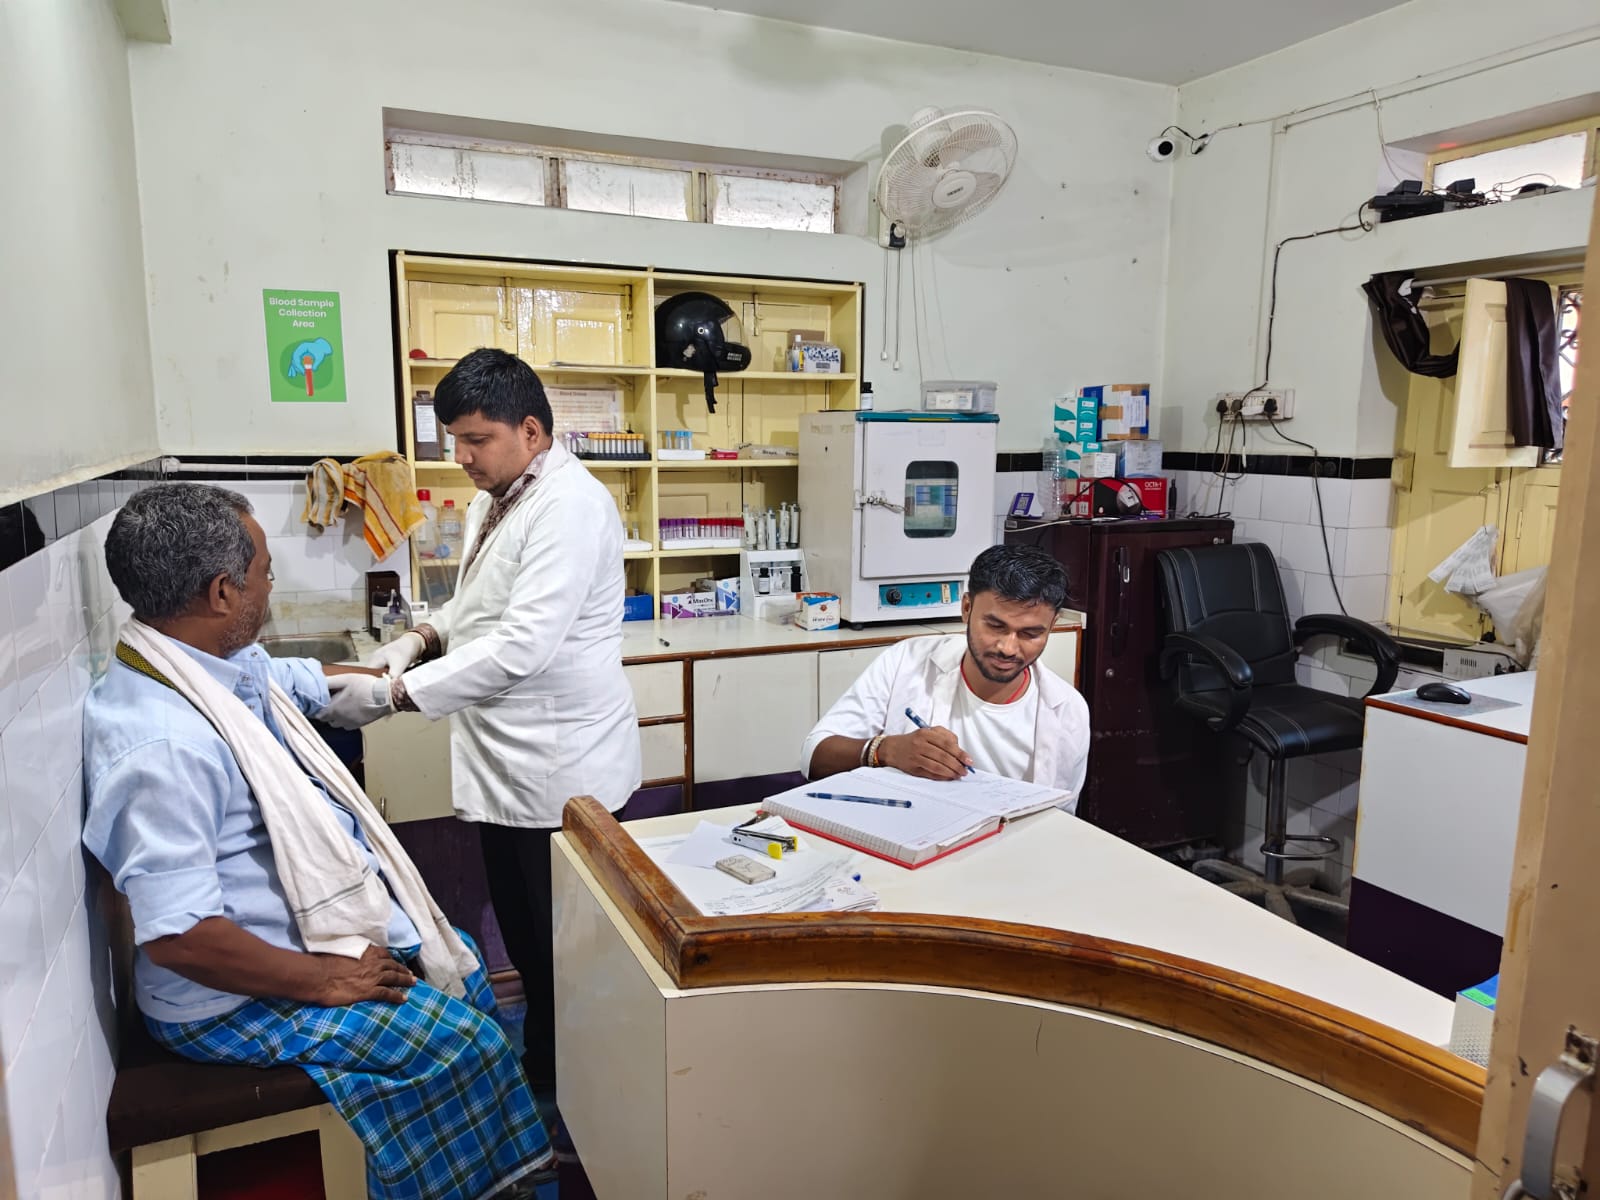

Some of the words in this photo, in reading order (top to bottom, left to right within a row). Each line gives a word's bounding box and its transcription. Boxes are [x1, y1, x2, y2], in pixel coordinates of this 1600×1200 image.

[269, 298, 297, 306] Blood
[298, 298, 334, 308] Sample
[278, 308, 327, 318] Collection
[292, 319, 315, 328] Area
